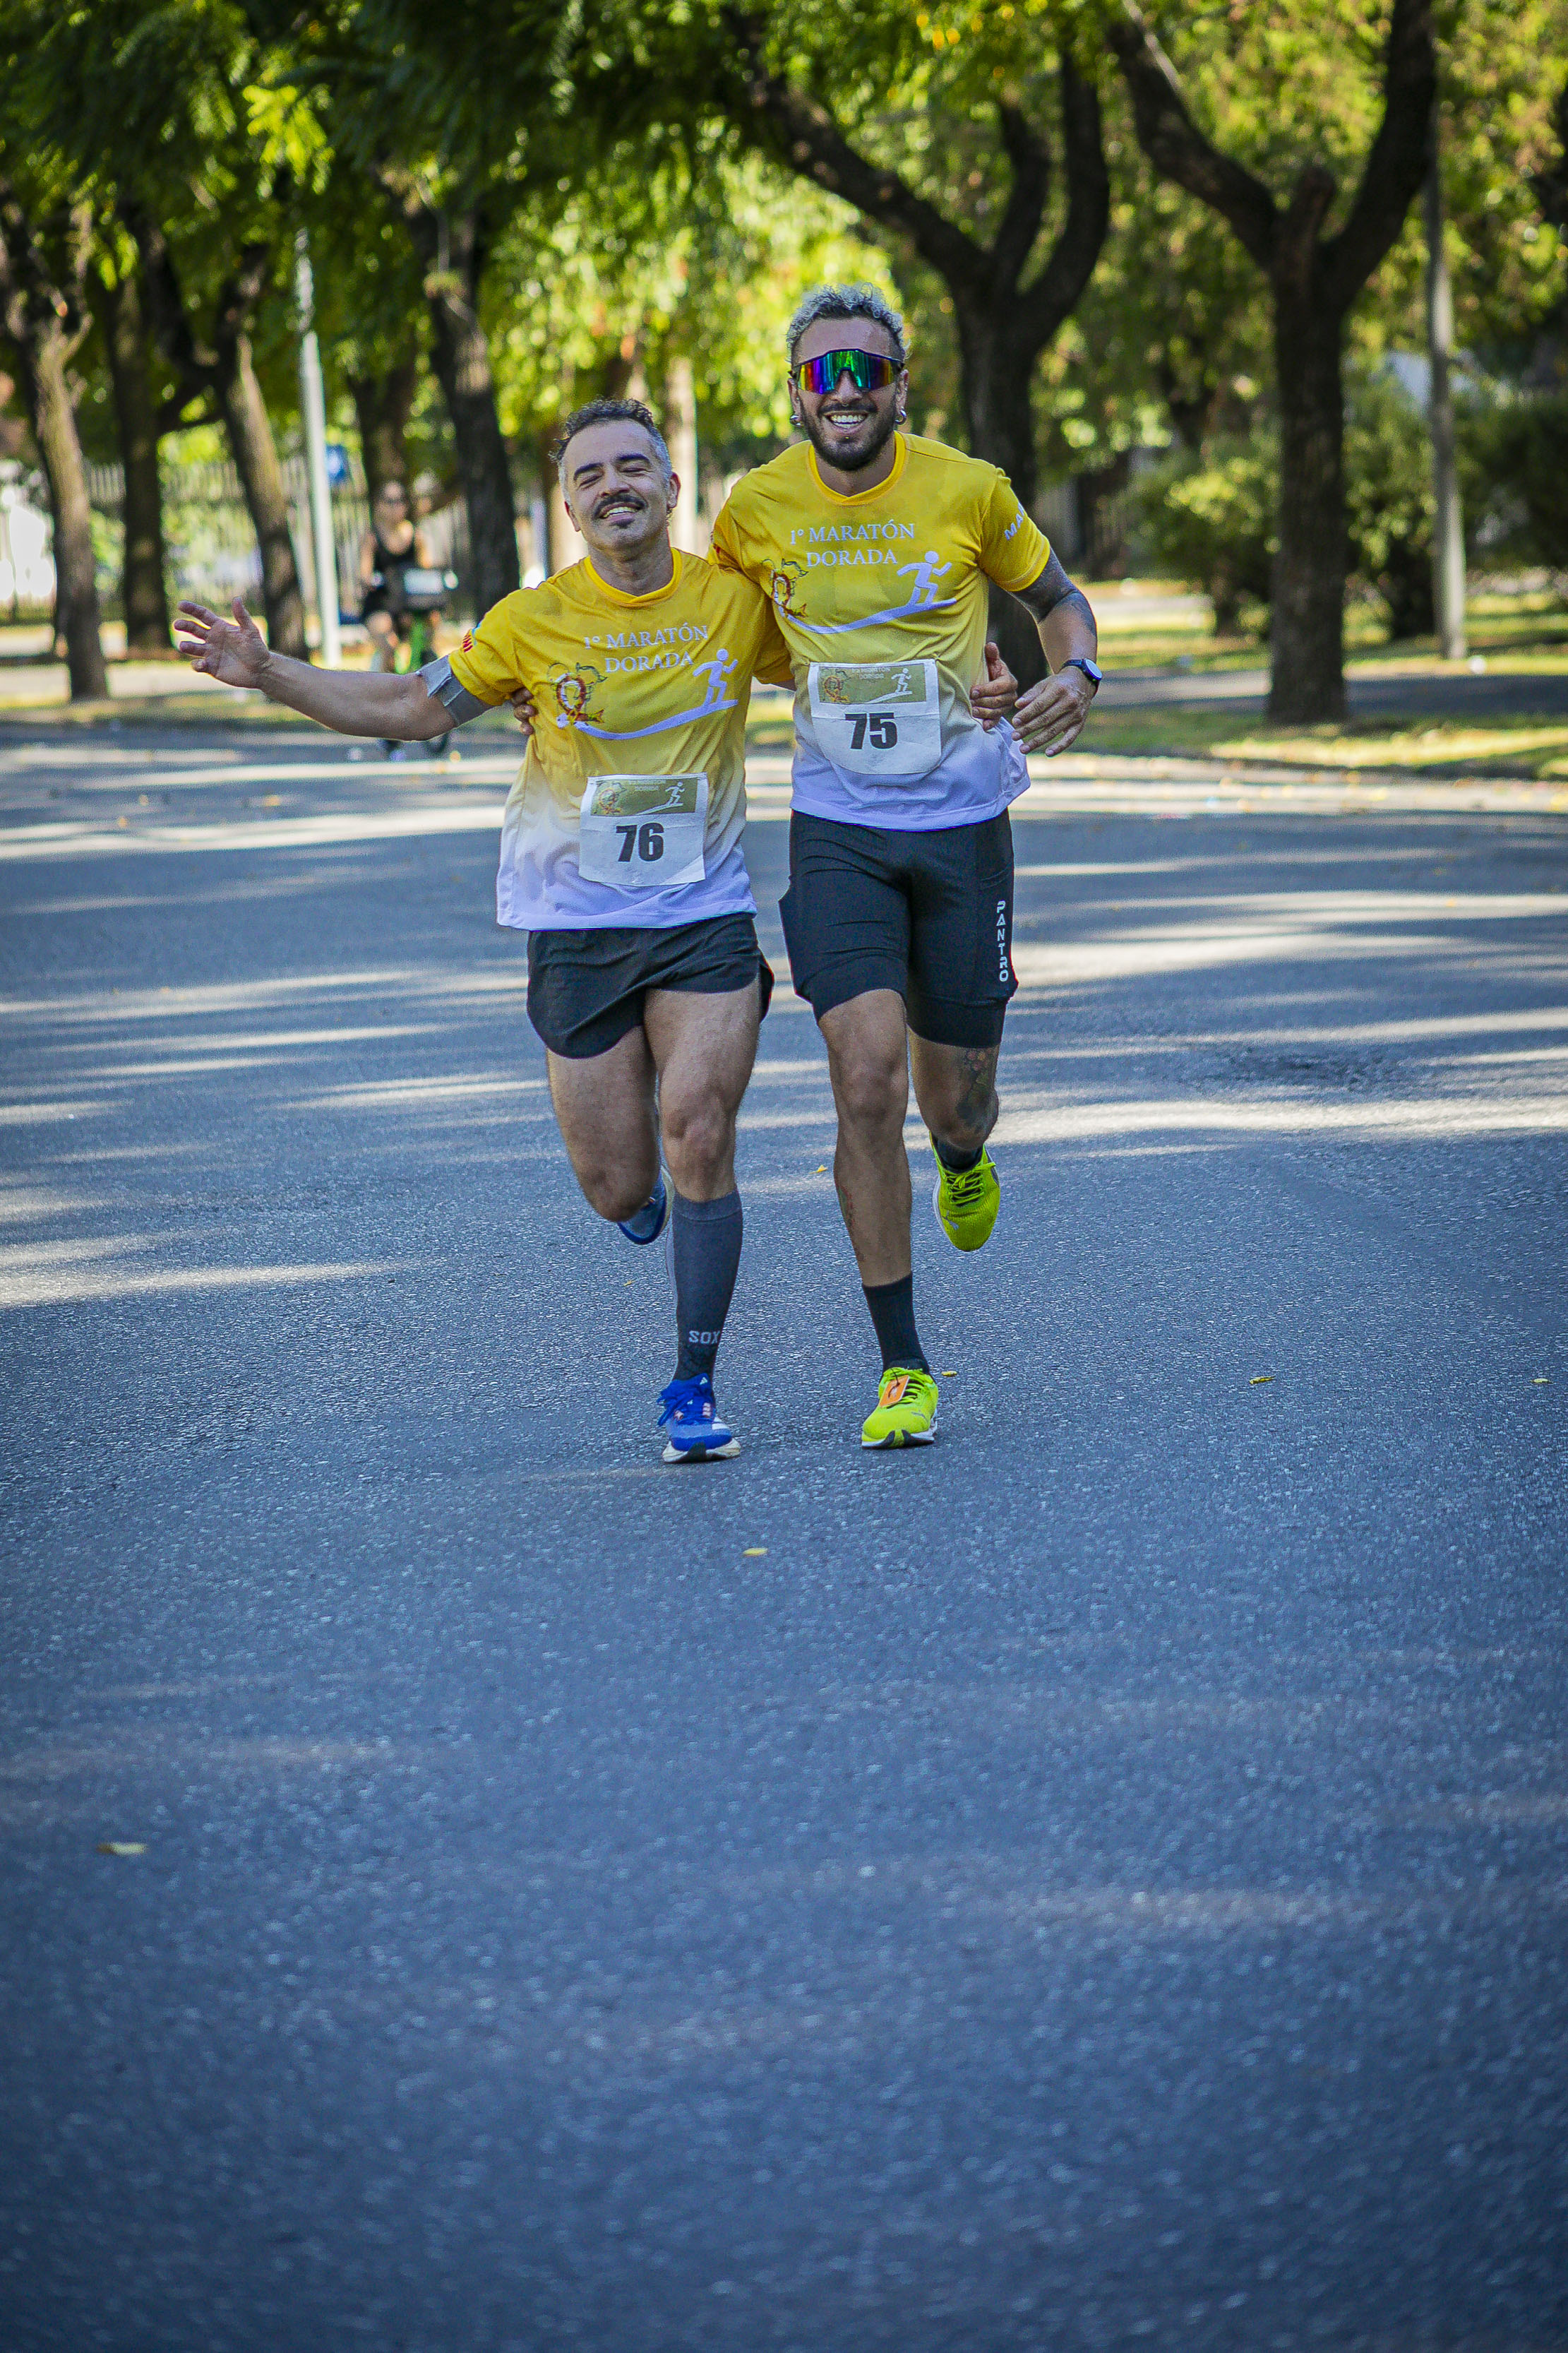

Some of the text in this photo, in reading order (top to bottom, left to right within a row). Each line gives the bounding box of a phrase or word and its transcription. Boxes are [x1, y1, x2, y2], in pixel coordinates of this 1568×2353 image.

[808, 518, 915, 543] MARATÓN
[806, 548, 898, 567] DORADA
[606, 621, 709, 649] MARATÓN
[604, 650, 694, 673] DORADA
[844, 712, 898, 750] 75
[615, 822, 664, 862] 76
[996, 900, 1009, 982] PANTRO
